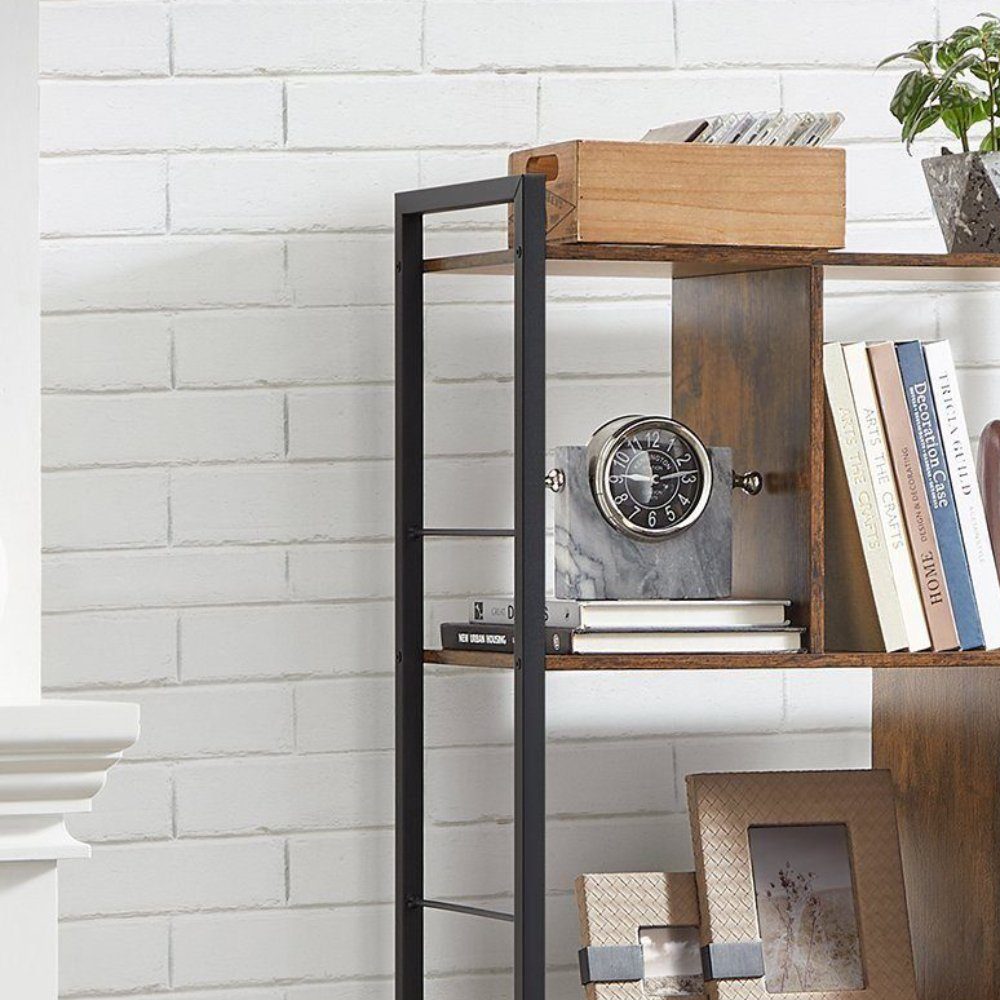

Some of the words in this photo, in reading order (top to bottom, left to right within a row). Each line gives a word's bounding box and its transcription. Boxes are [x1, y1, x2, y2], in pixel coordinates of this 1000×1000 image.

[645, 431, 660, 448] 12
[939, 371, 959, 435] TRICIA
[952, 440, 972, 496] GUILD
[627, 436, 643, 454] 11
[666, 438, 676, 452] 1
[914, 382, 940, 468] Decoration
[932, 470, 949, 508] Case
[613, 451, 630, 469] 10
[676, 453, 692, 467] 2
[609, 474, 624, 484] 9
[681, 474, 697, 484] 3
[863, 408, 882, 446] ARTS
[874, 452, 890, 485] THE
[882, 491, 904, 550] CRAFTS
[902, 446, 919, 502] DECORATING
[614, 493, 629, 505] 8
[677, 493, 691, 506] 4
[628, 506, 641, 520] 7
[648, 510, 657, 528] 6
[664, 505, 676, 522] 5
[915, 511, 928, 543] DESIGN
[920, 551, 943, 605] HOME
[458, 633, 469, 643] NEW
